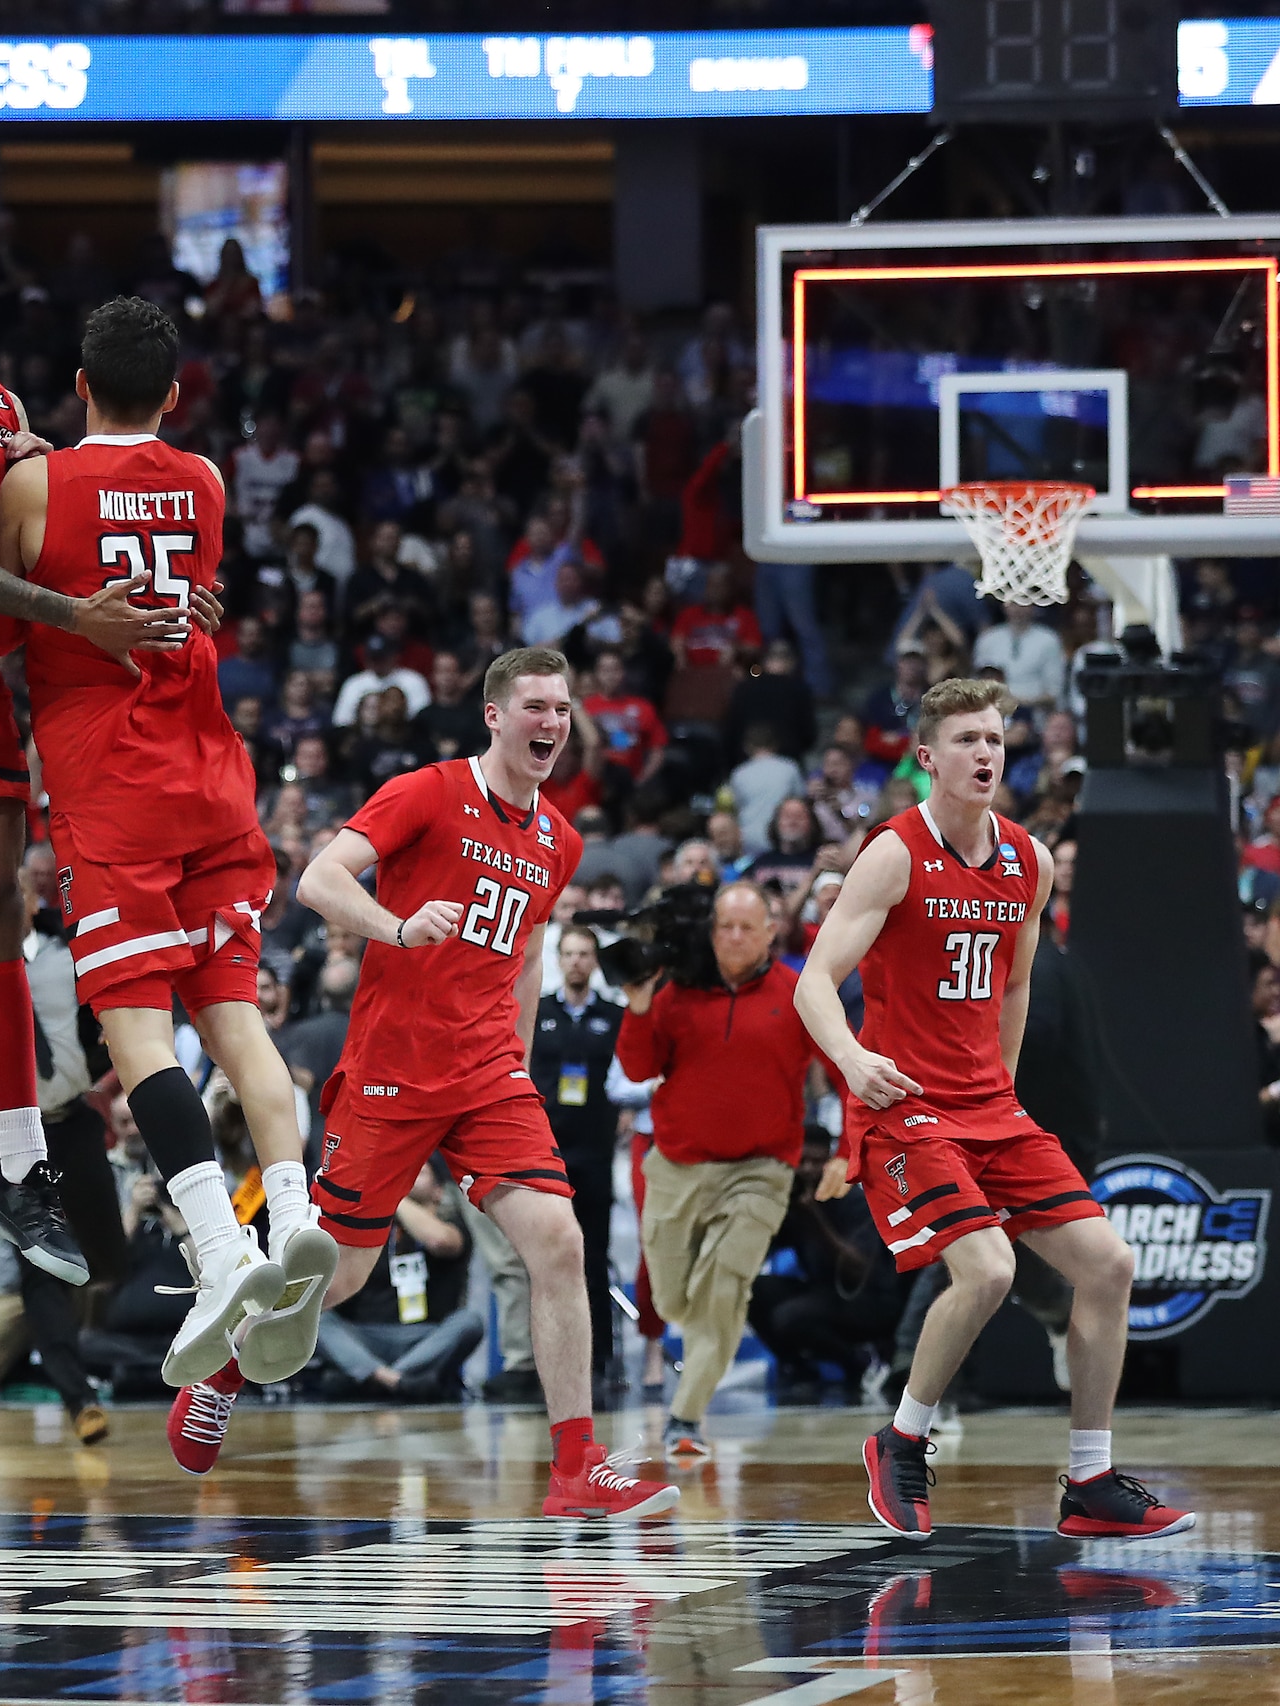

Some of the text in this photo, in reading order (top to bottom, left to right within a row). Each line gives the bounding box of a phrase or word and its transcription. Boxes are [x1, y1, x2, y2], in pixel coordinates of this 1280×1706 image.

[98, 489, 196, 521] MORETTI
[100, 534, 195, 639] 25
[461, 837, 551, 889] TEXAS TECH
[461, 876, 530, 956] 20
[924, 897, 1027, 923] TEXAS TECH
[938, 932, 1000, 1000] 30
[363, 1085, 399, 1097] GUNS UP
[1104, 1203, 1202, 1244] ARCH
